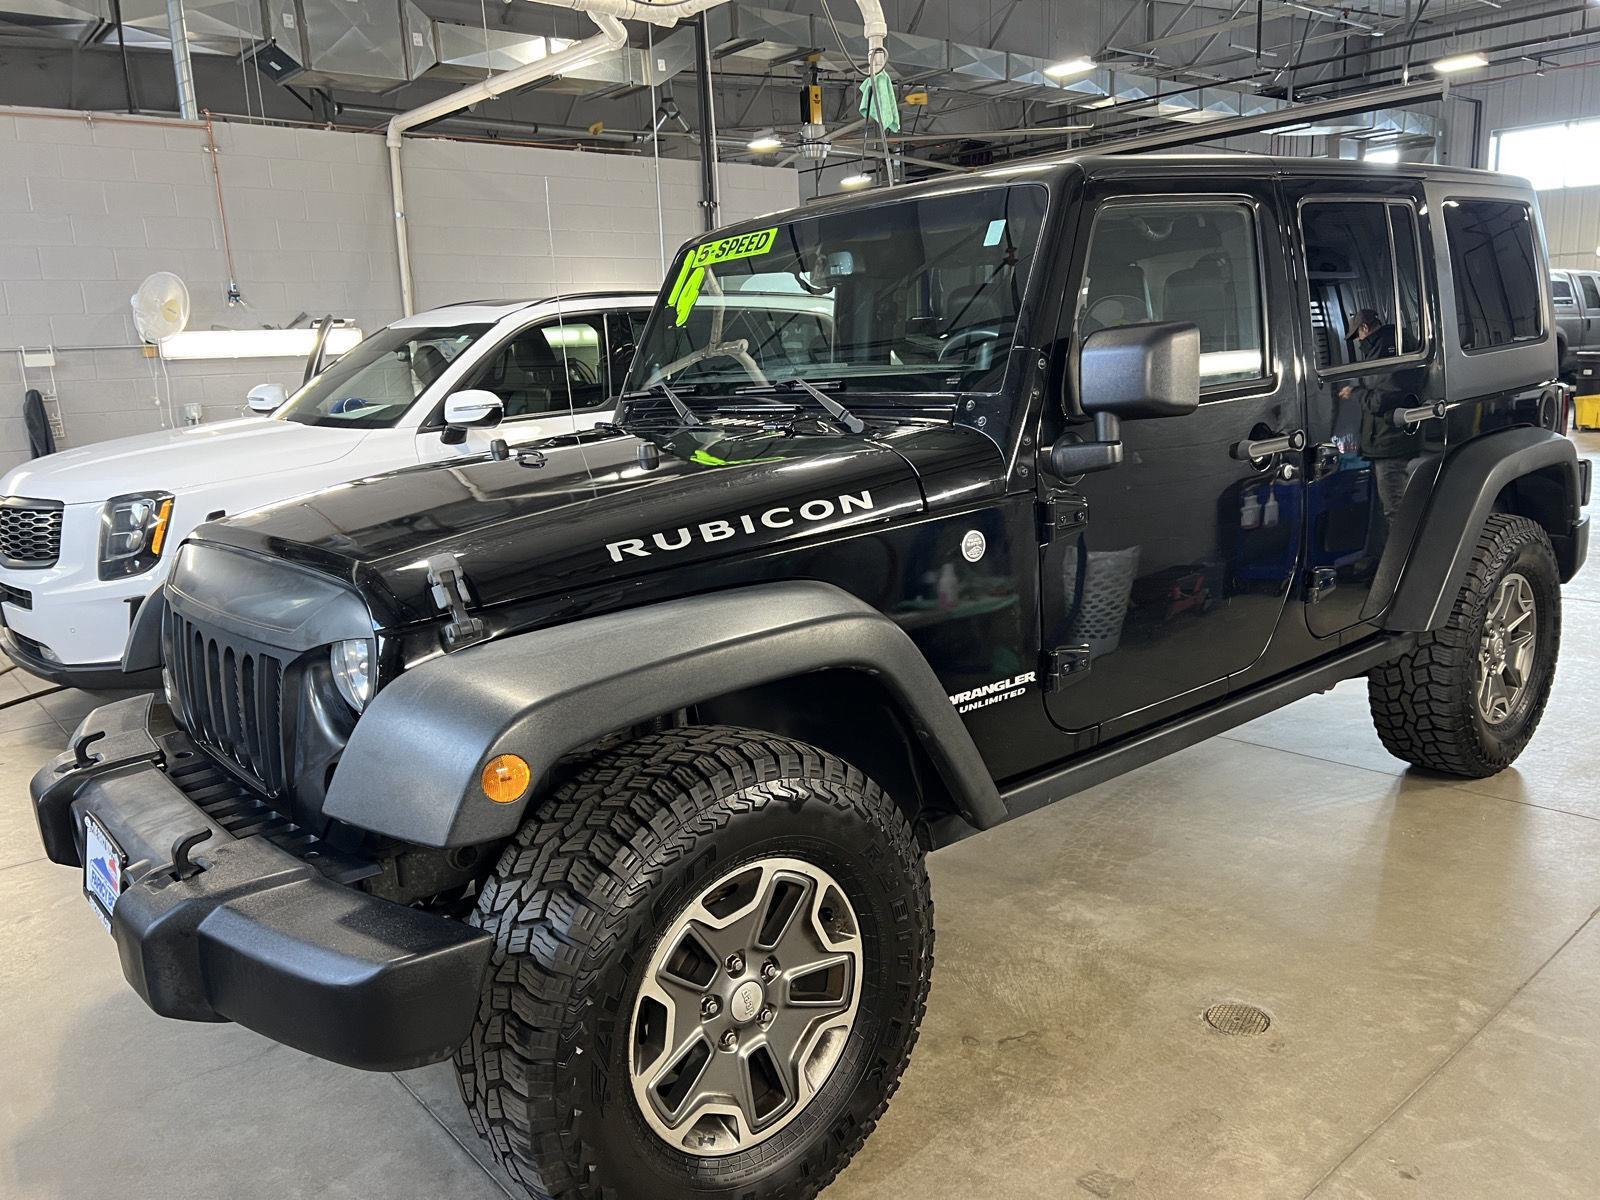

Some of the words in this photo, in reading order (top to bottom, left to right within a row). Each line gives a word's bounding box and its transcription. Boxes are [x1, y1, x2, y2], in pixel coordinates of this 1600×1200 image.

[697, 231, 771, 263] 5-SPEED
[605, 490, 874, 562] RUBICON
[959, 687, 1026, 714] UNLIMITED
[741, 988, 756, 1017] Jeep
